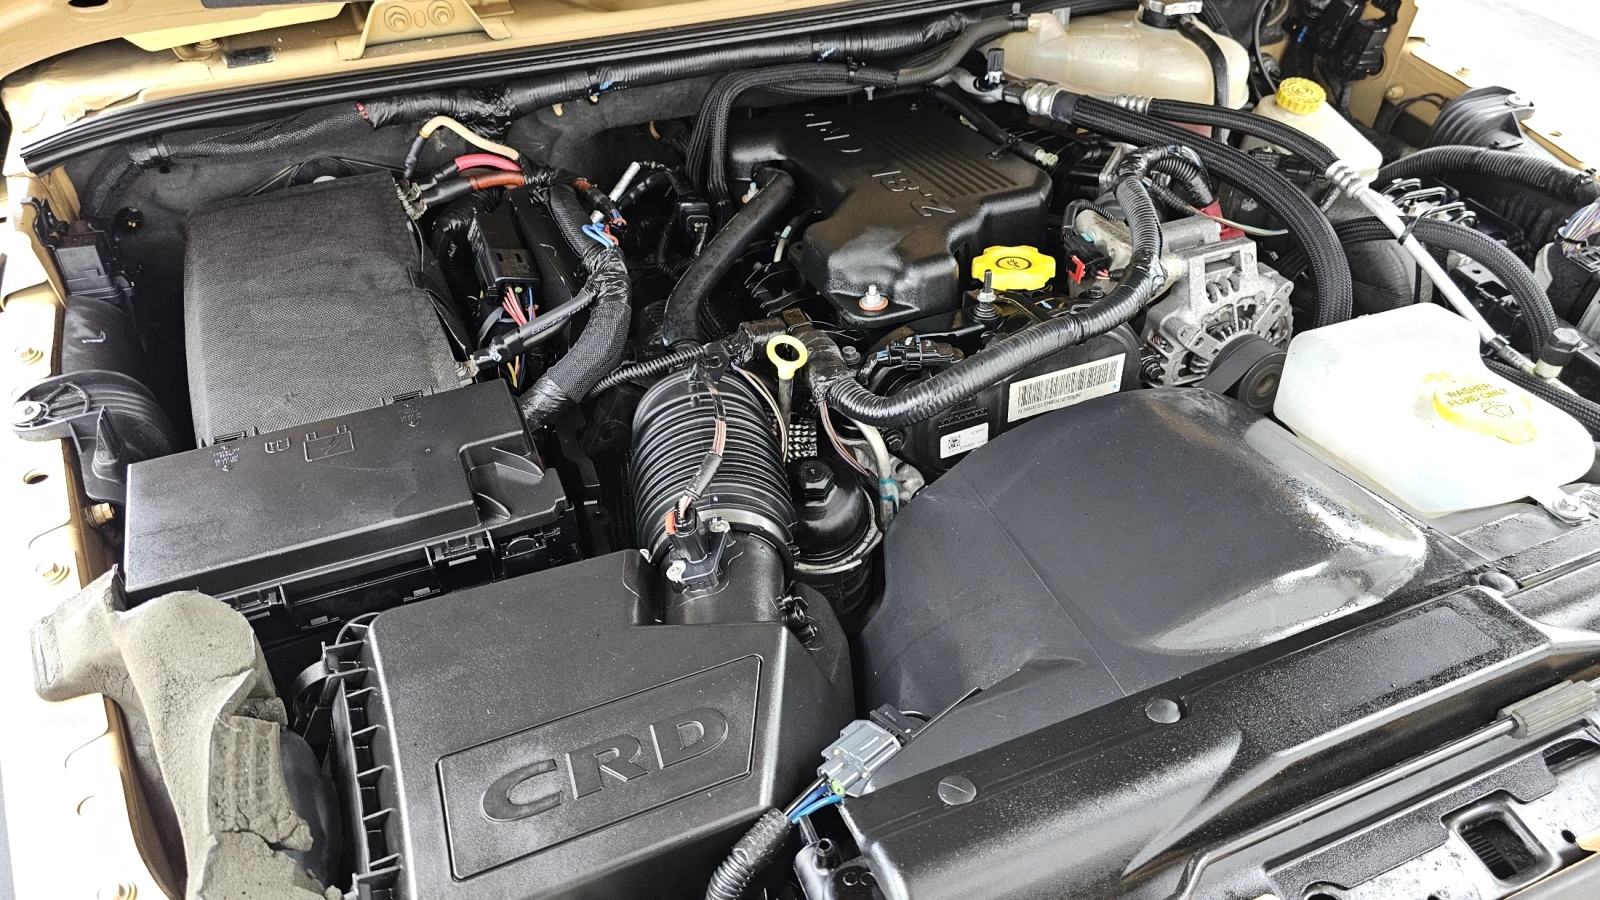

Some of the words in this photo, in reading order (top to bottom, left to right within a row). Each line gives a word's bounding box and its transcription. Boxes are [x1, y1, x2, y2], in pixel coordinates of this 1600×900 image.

[1444, 383, 1493, 398] WASHER
[1446, 395, 1480, 407] FLUID
[1480, 388, 1508, 399] ONLY
[480, 708, 729, 822] CRD
